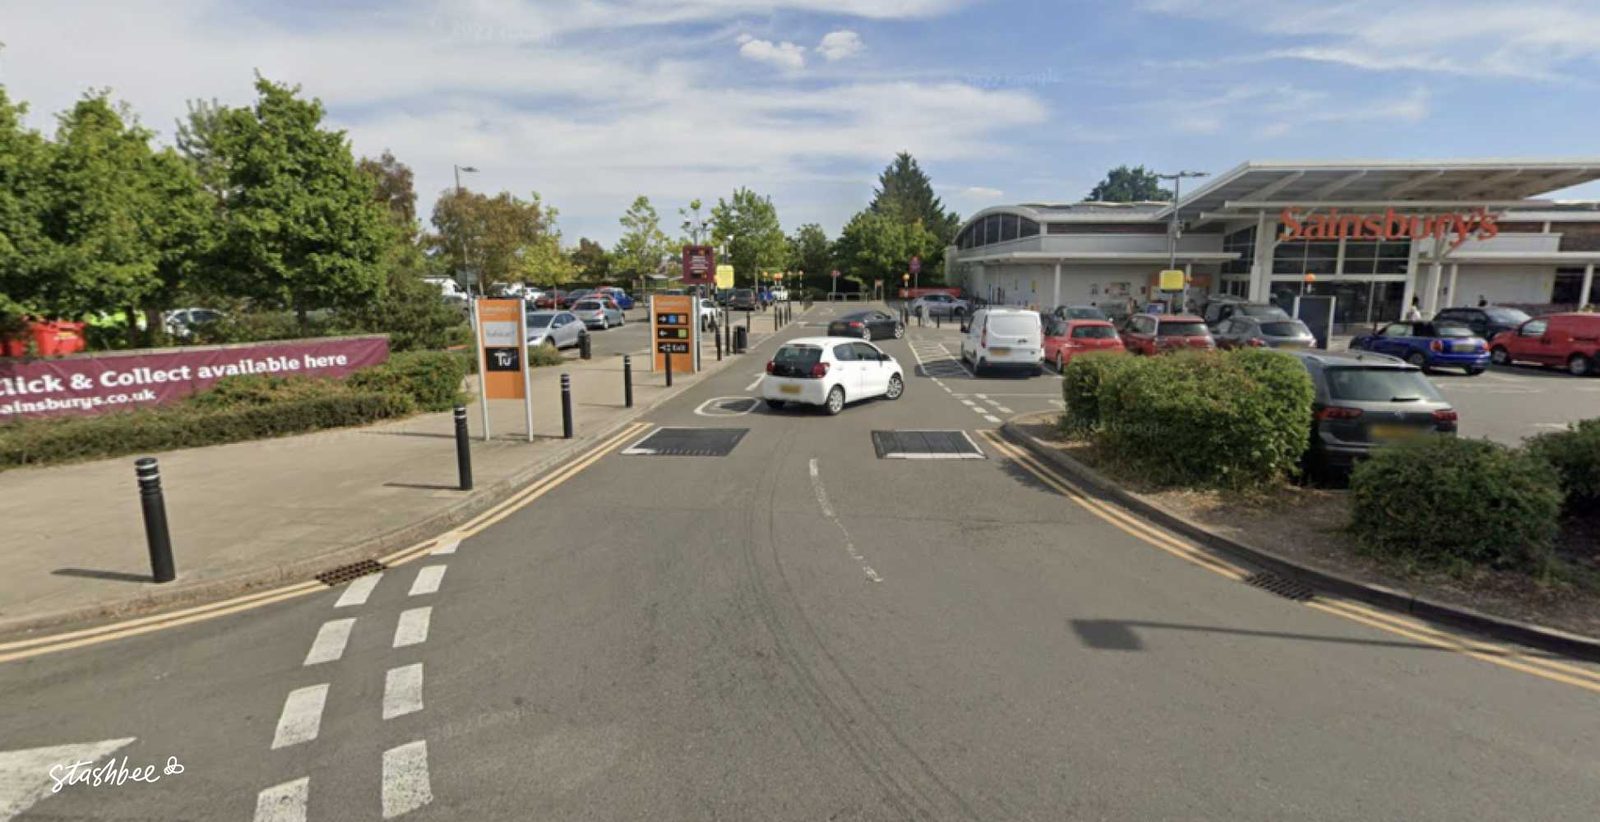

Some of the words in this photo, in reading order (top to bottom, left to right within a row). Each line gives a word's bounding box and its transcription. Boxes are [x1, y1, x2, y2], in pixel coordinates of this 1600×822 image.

[1280, 206, 1499, 252] Sainsbury's
[0, 374, 64, 397] lick
[70, 373, 93, 390] &
[100, 365, 192, 388] Collect
[198, 356, 301, 379] available
[304, 354, 348, 369] here
[0, 389, 156, 415] ainsburys.co.uk
